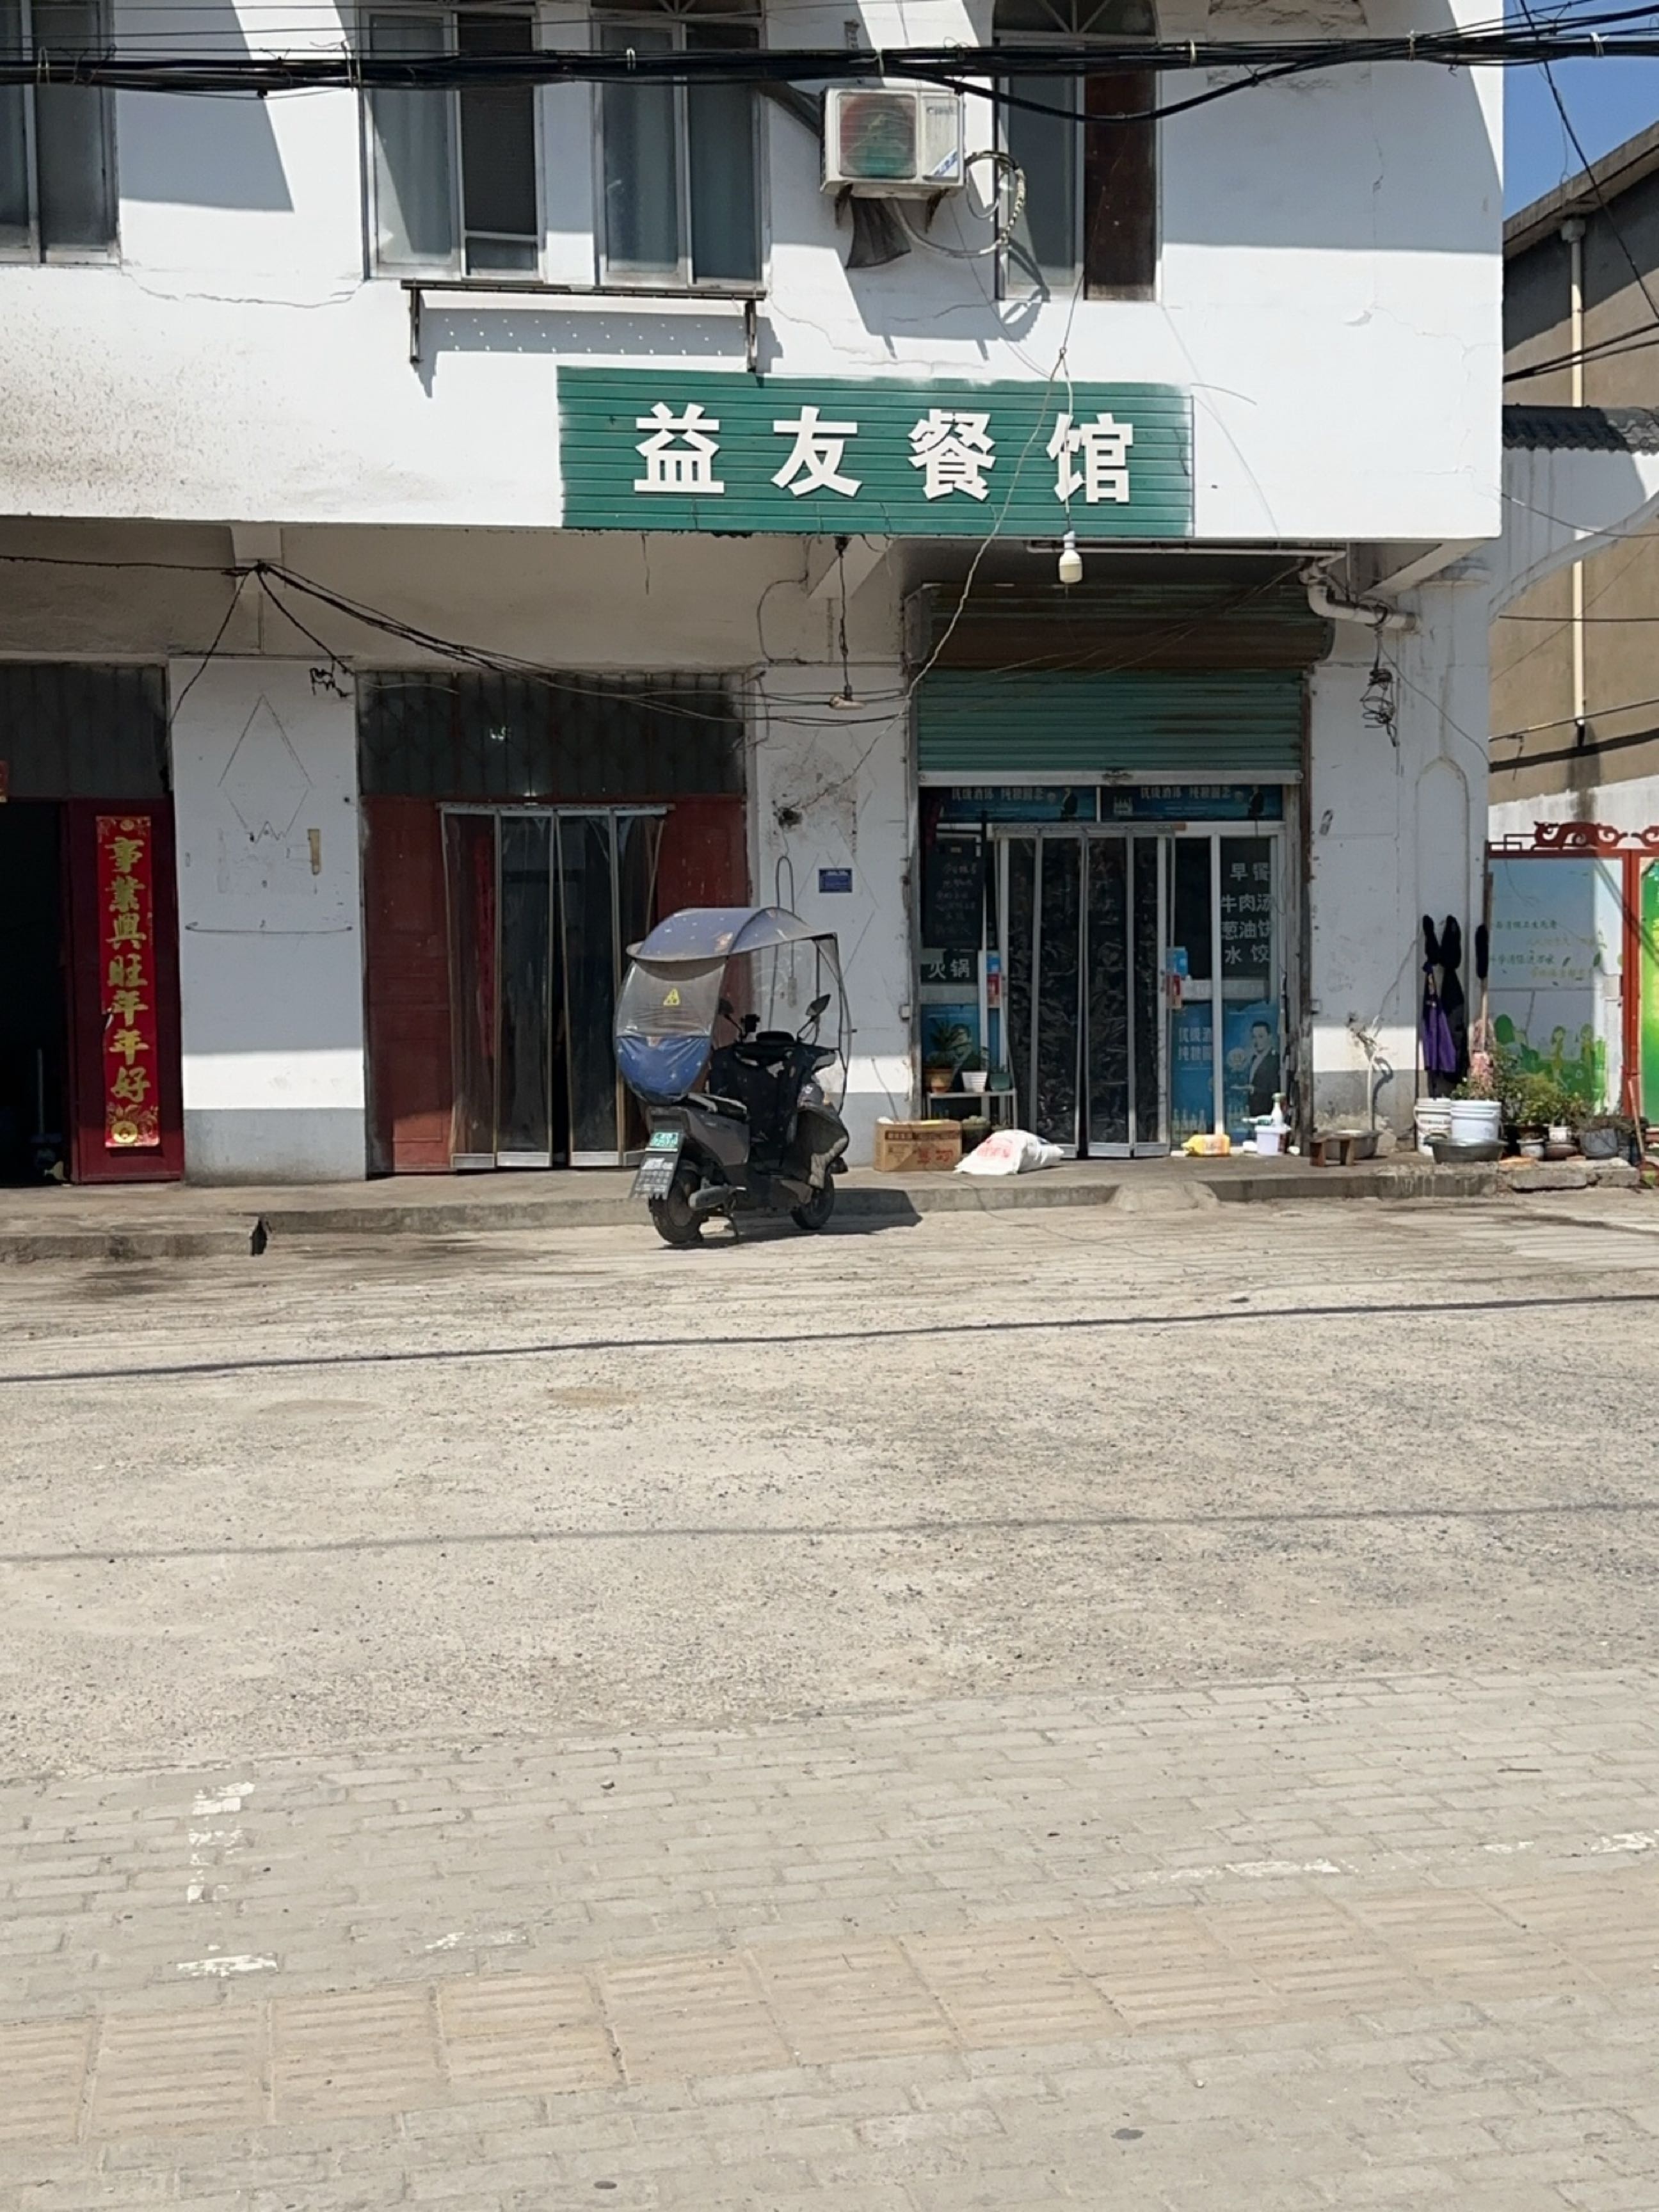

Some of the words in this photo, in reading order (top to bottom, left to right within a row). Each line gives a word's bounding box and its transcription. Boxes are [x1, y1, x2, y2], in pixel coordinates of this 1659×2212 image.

[634, 401, 1134, 504] 益友餐馆
[1221, 894, 1271, 913] 牛肉汤
[1224, 945, 1271, 965] 水饺
[105, 837, 151, 1103] 事業興旺年年好
[928, 958, 970, 979] 火锅
